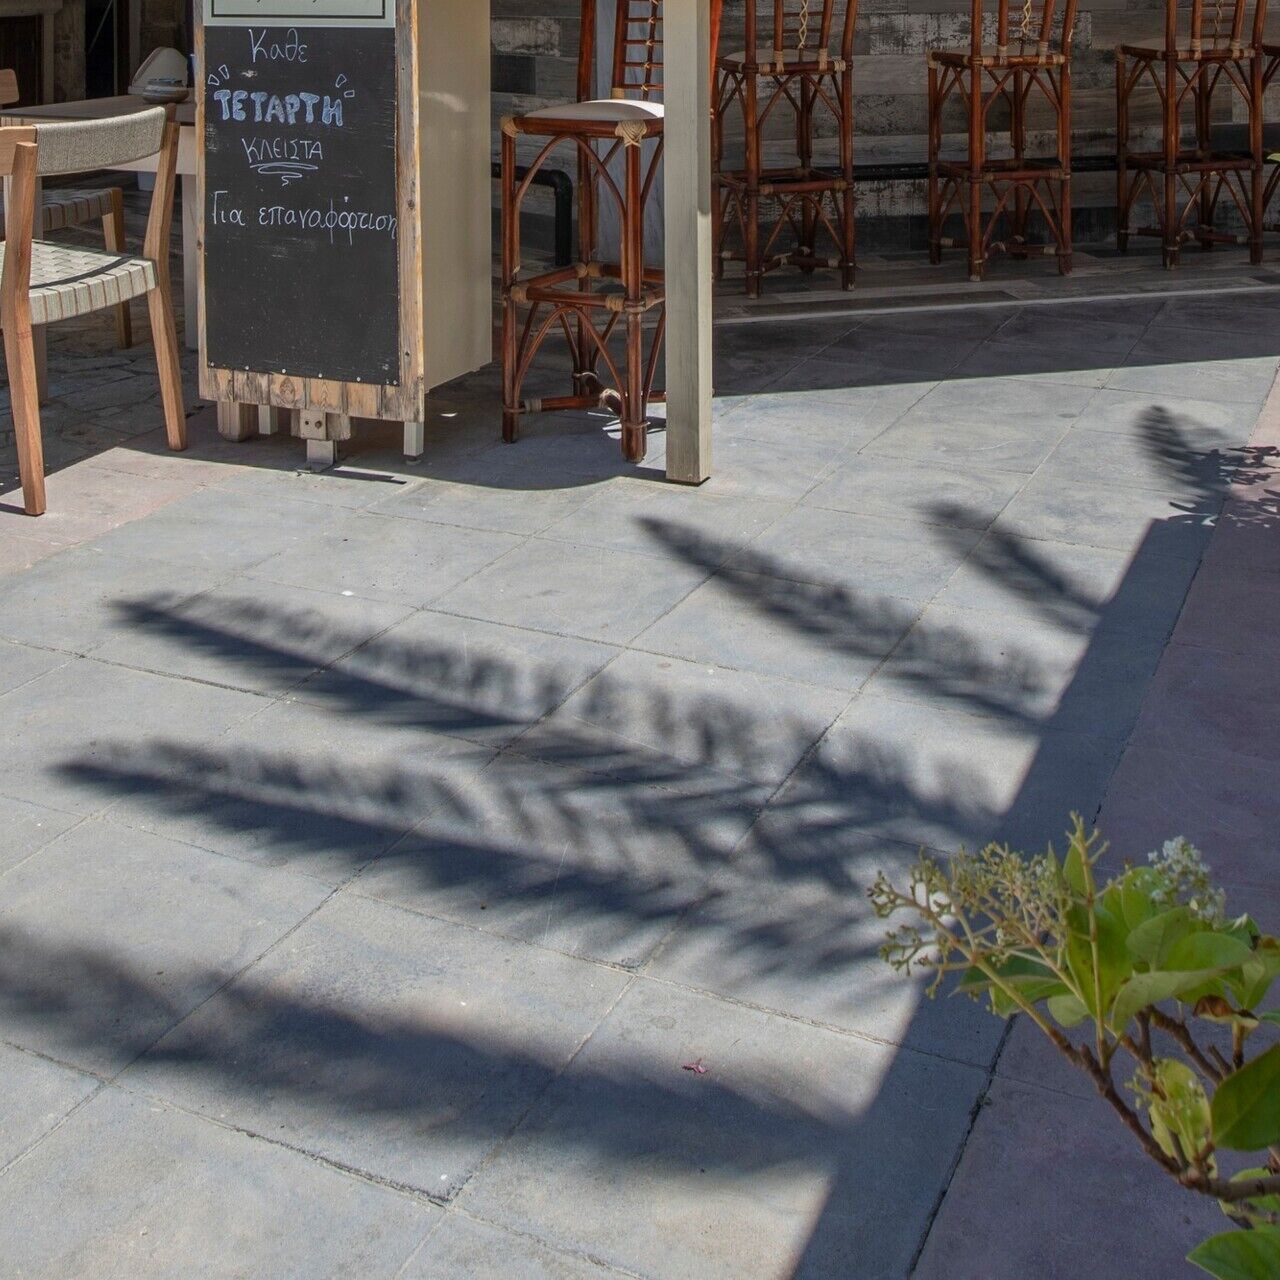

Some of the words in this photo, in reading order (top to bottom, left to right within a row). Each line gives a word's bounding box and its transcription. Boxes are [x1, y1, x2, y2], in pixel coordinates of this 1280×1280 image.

[213, 89, 343, 127] ΤΕΤΑΡΤΗ
[241, 137, 323, 163] ΚΛΕΙΣΤΑ
[212, 190, 246, 227] Για
